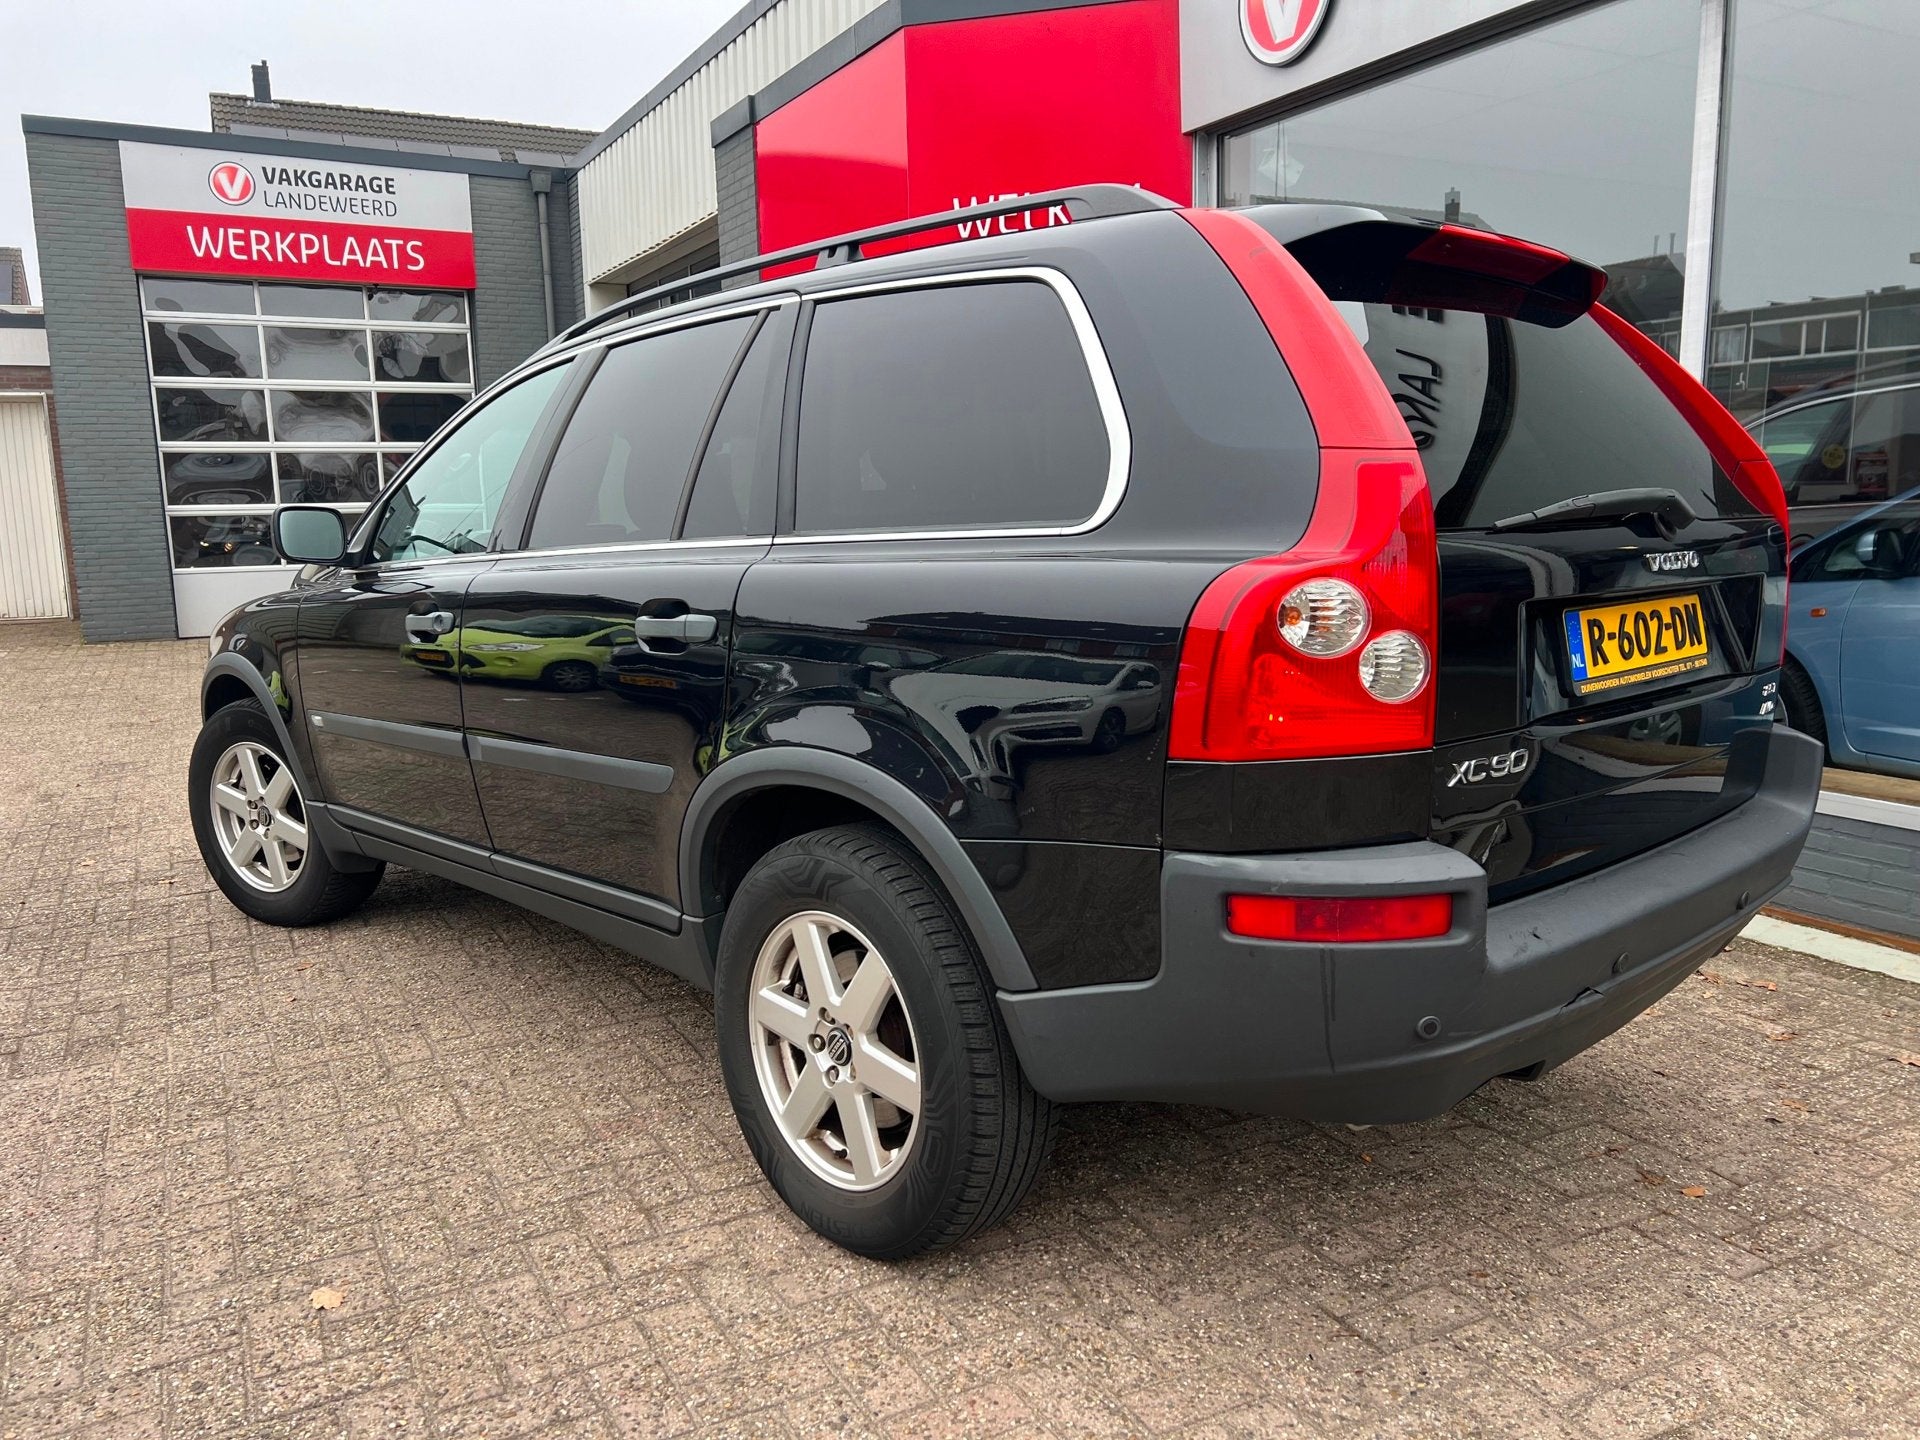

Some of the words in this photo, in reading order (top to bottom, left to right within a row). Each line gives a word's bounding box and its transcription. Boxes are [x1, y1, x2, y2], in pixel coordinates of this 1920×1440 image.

[262, 166, 396, 195] VAKGARAGE
[264, 190, 397, 217] LANDEWEERD
[186, 225, 424, 271] WERKPLAATS
[1643, 550, 1700, 571] VOLVO
[1586, 602, 1704, 668] R-602-DN
[1571, 653, 1585, 668] NL
[1446, 748, 1529, 788] XC90
